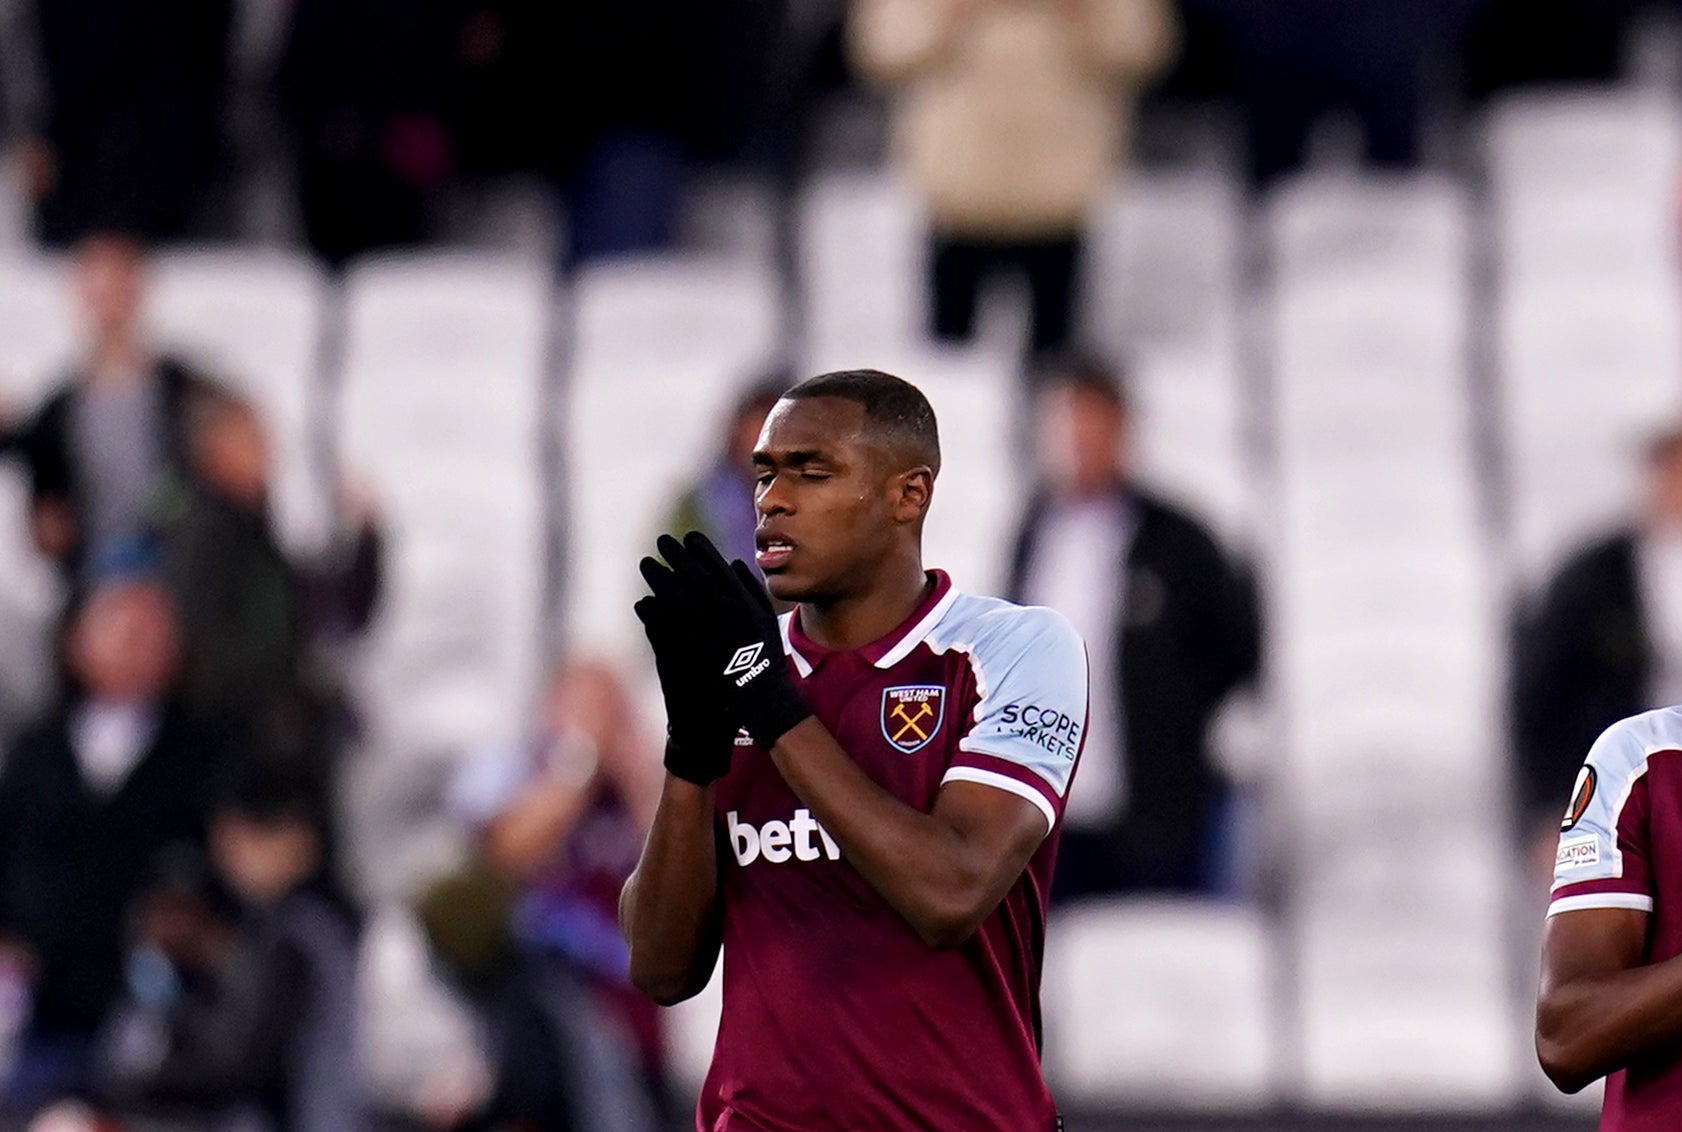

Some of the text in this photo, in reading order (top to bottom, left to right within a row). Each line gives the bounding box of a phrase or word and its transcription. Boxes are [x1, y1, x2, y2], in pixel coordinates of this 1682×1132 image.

[736, 658, 770, 687] umbro
[916, 689, 939, 697] HAM
[1001, 704, 1079, 746] SCOPE
[727, 808, 841, 867] bet
[1557, 844, 1596, 861] DATION
